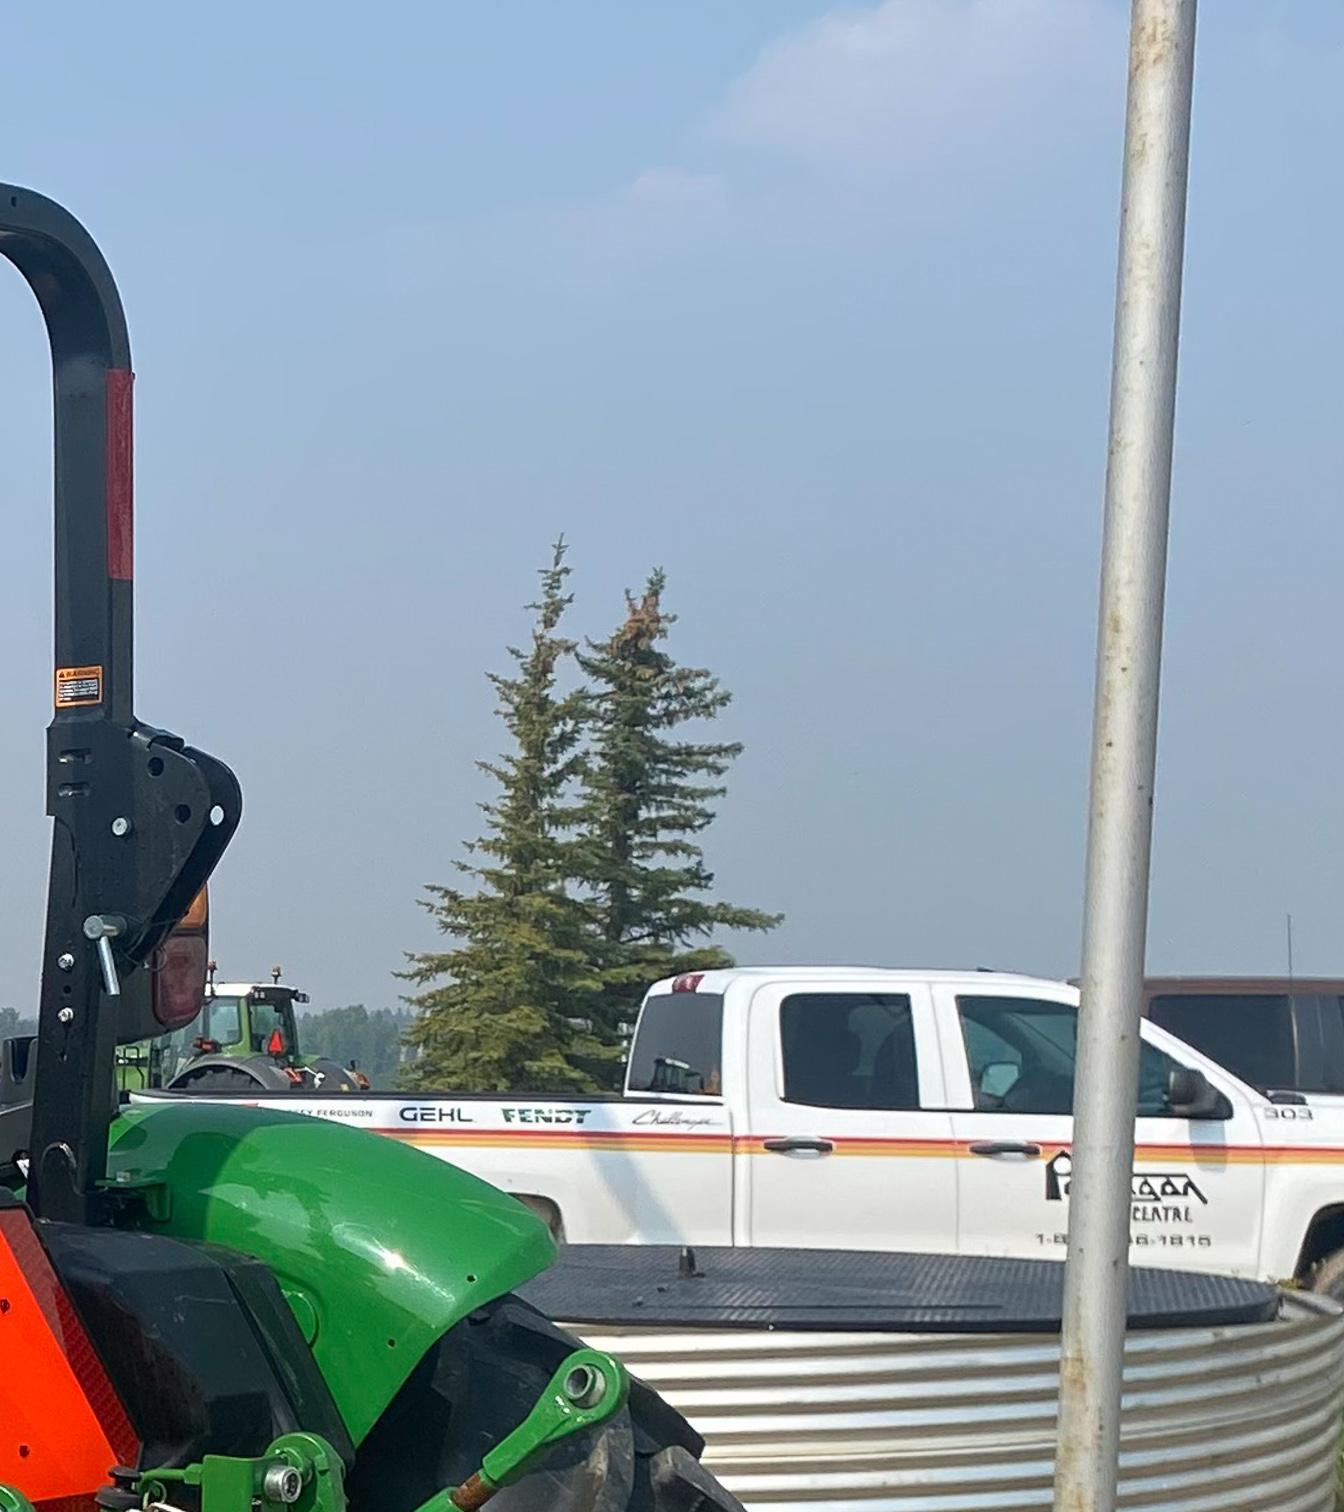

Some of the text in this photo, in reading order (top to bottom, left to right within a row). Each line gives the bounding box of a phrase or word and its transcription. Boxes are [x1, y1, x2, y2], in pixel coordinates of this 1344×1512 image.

[316, 1109, 374, 1118] FERGUSON
[398, 1106, 474, 1123] GEHL
[500, 1107, 593, 1125] FENDT
